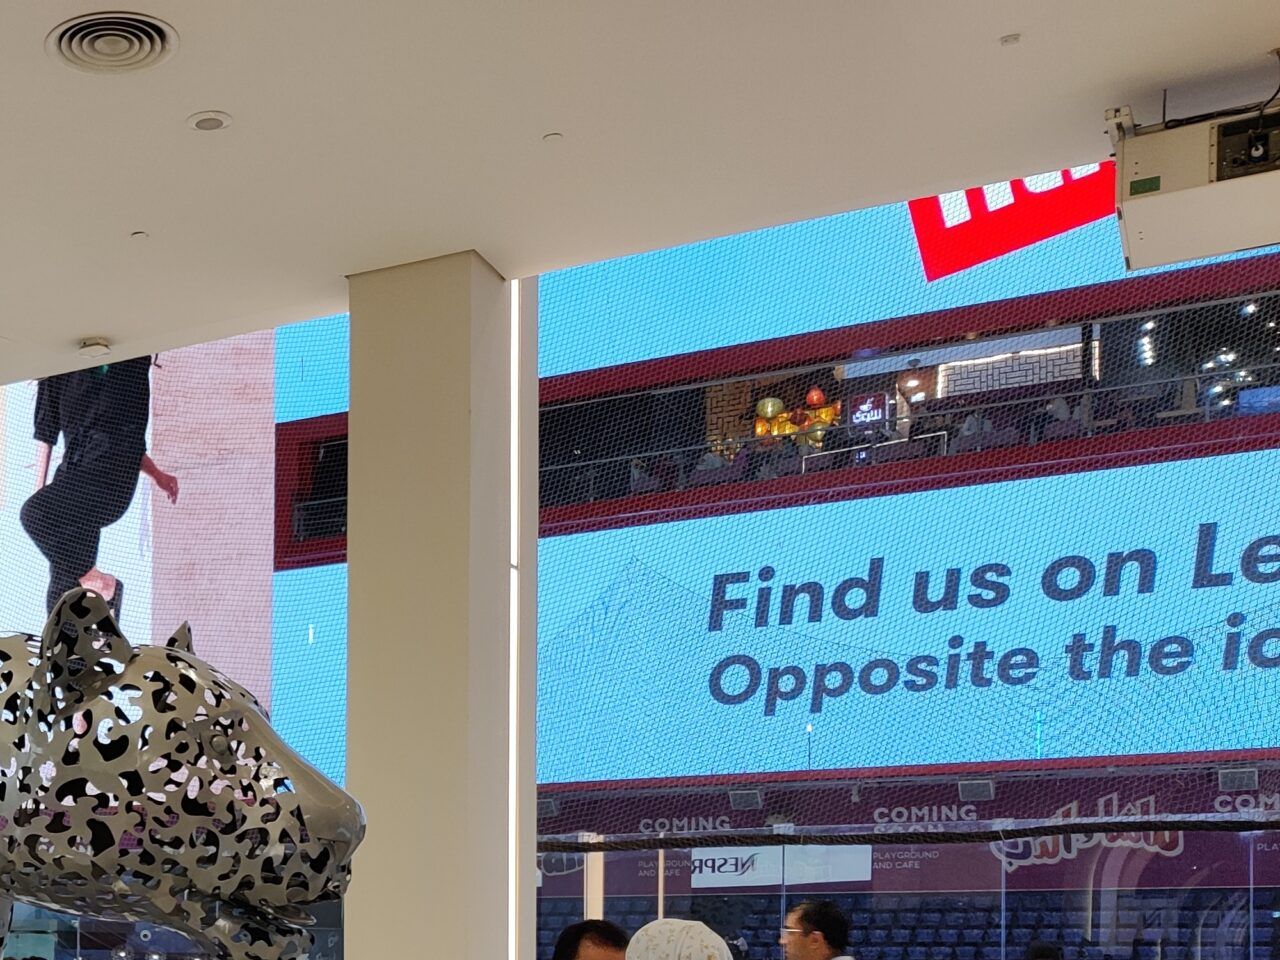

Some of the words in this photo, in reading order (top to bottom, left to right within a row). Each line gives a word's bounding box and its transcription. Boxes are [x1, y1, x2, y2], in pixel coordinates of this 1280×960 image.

[708, 556, 884, 632] Find
[912, 562, 1012, 614] us
[1041, 548, 1157, 602] on
[708, 635, 1040, 716] Opposite
[1065, 625, 1195, 681] the
[873, 805, 977, 823] COMING
[639, 816, 731, 833] COMING
[873, 851, 940, 860] PLAYGROUND
[1257, 843, 1280, 851] PLA
[873, 861, 893, 869] AND
[895, 861, 920, 869] CAFE
